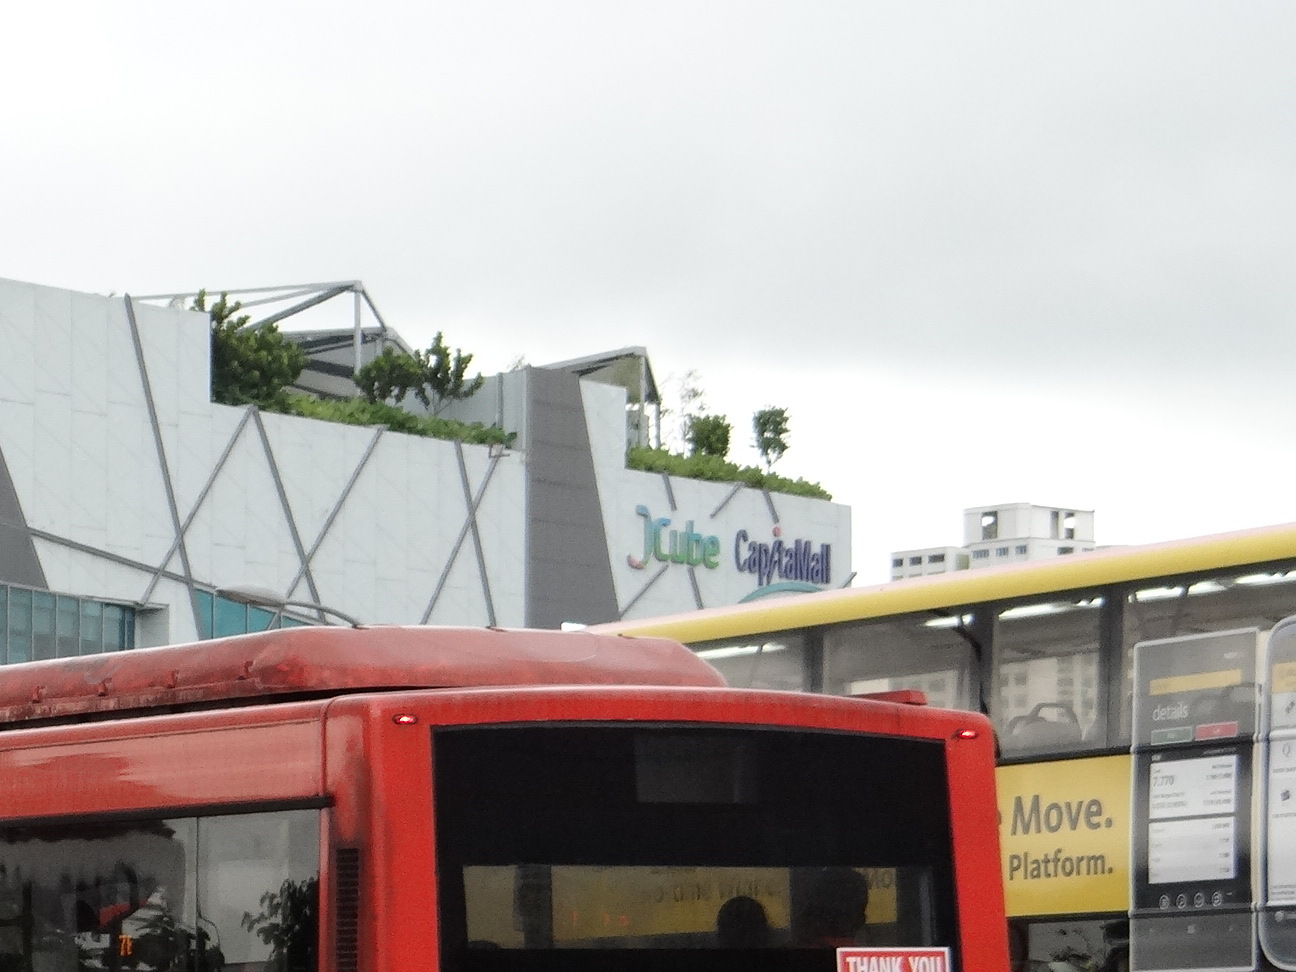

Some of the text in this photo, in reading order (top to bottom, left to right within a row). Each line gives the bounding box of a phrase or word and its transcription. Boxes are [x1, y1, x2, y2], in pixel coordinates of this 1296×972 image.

[734, 526, 831, 586] CapitaMall
[1010, 794, 1113, 836] Move.
[1008, 848, 1114, 880] Platform.
